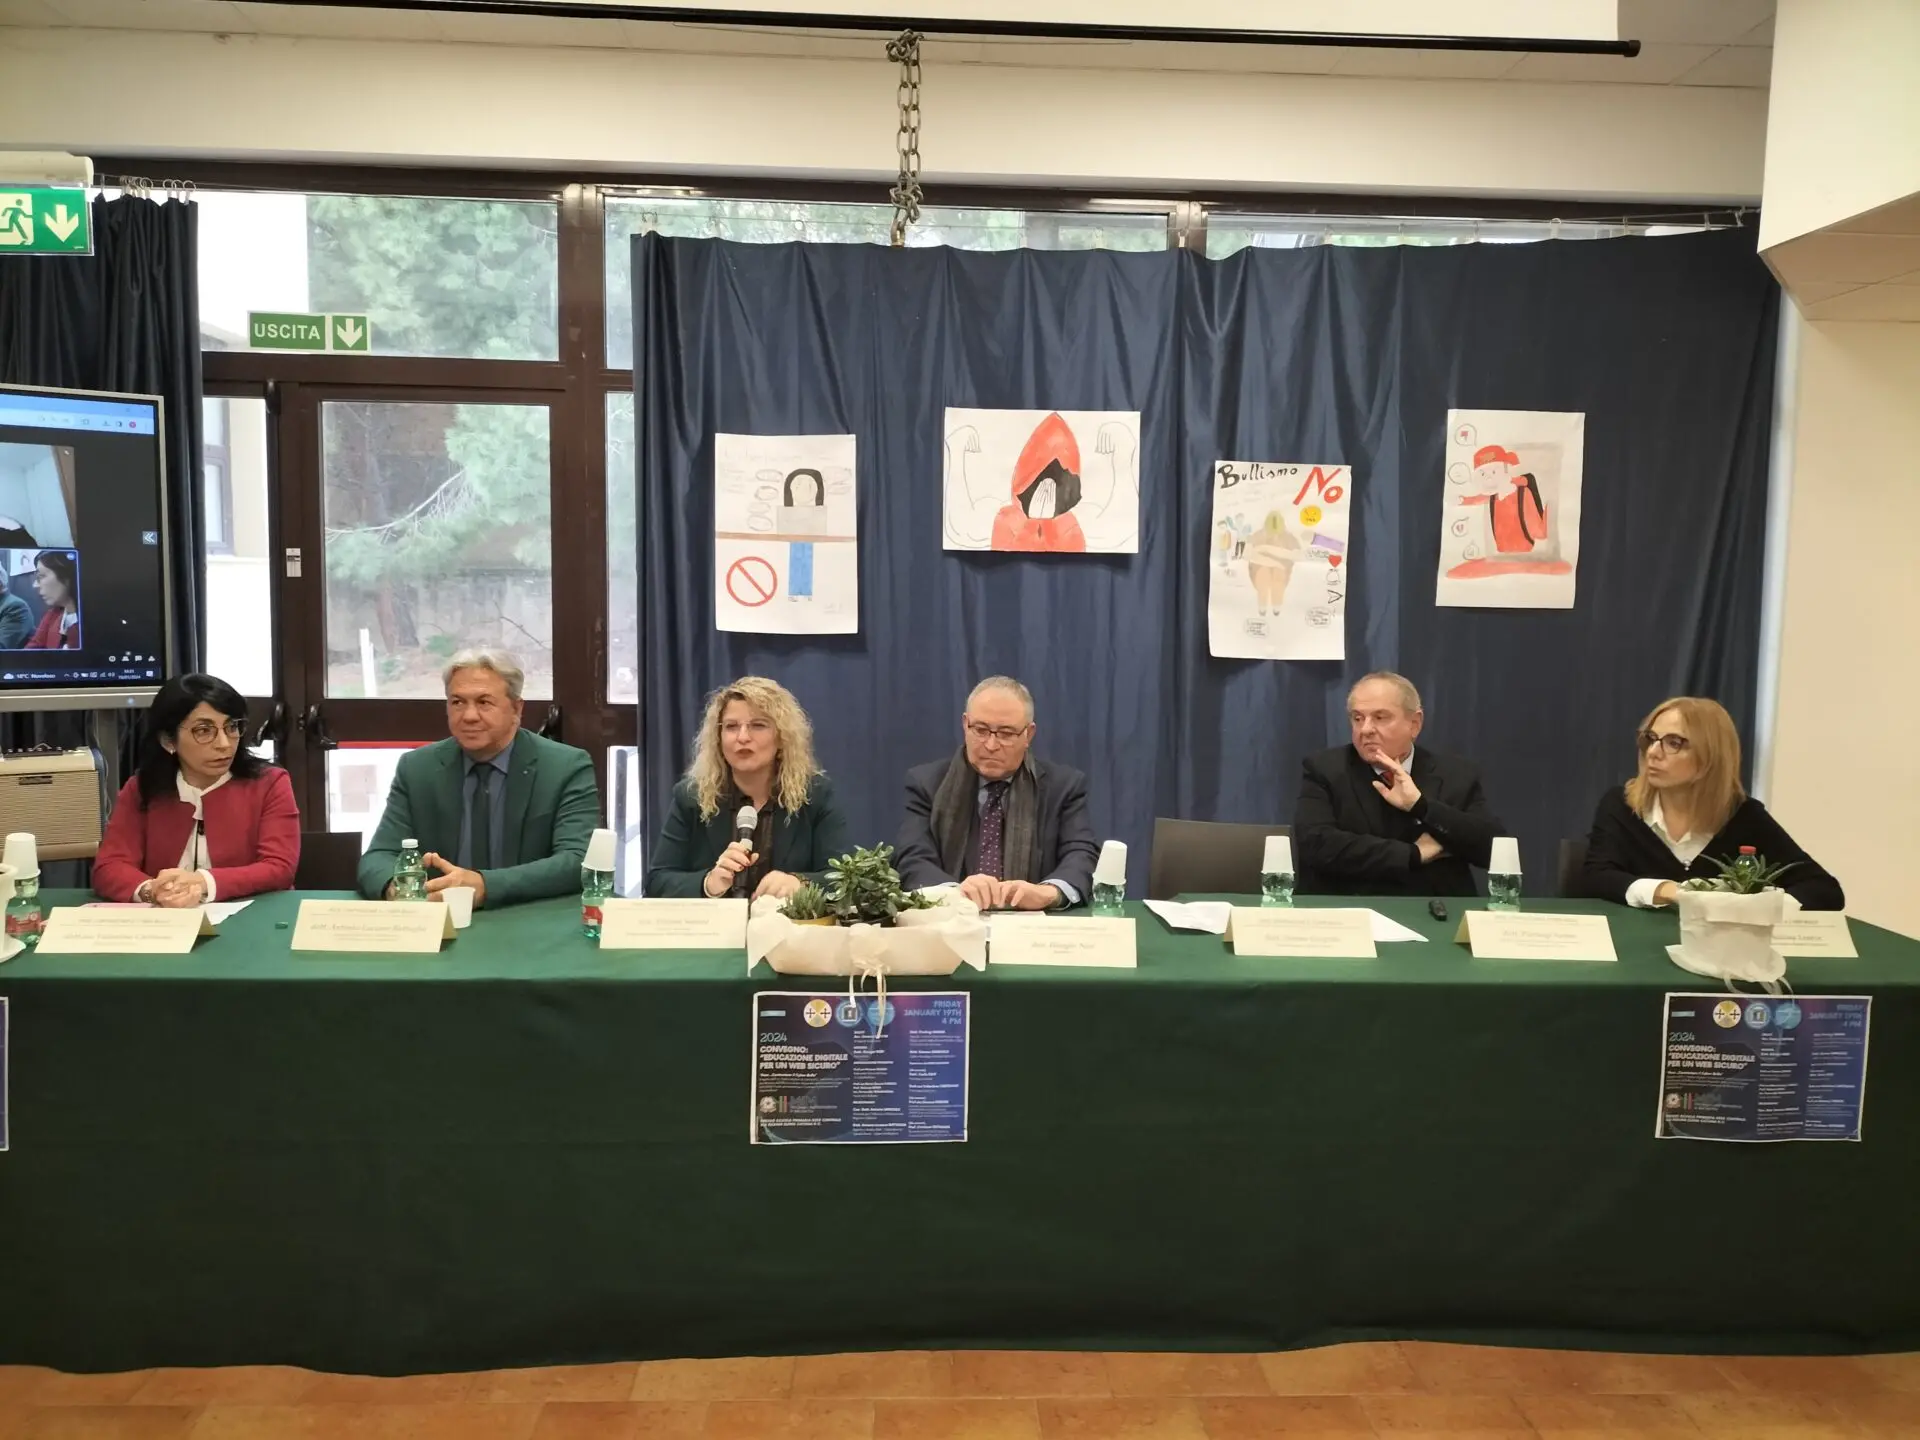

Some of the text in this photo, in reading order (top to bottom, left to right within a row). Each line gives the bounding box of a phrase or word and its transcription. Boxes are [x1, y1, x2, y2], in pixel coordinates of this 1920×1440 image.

[254, 323, 321, 340] USCITA
[1217, 463, 1298, 489] Bullismo
[1292, 466, 1344, 506] No
[934, 1000, 962, 1008] FRIDAY
[903, 1009, 941, 1017] JANUARY
[949, 1017, 962, 1025] PM
[760, 1032, 787, 1043] 2024
[1669, 1032, 1695, 1042] 2024
[760, 1045, 809, 1054] CONVEGNO:
[814, 1053, 849, 1062] DIGITALE
[1721, 1053, 1756, 1063] DIGITALE
[760, 1062, 774, 1070] PER
[775, 1062, 788, 1070] UN
[788, 1062, 806, 1070] WEB
[1667, 1060, 1681, 1068] PER
[1682, 1060, 1694, 1068] UN
[1695, 1061, 1713, 1069] WEB
